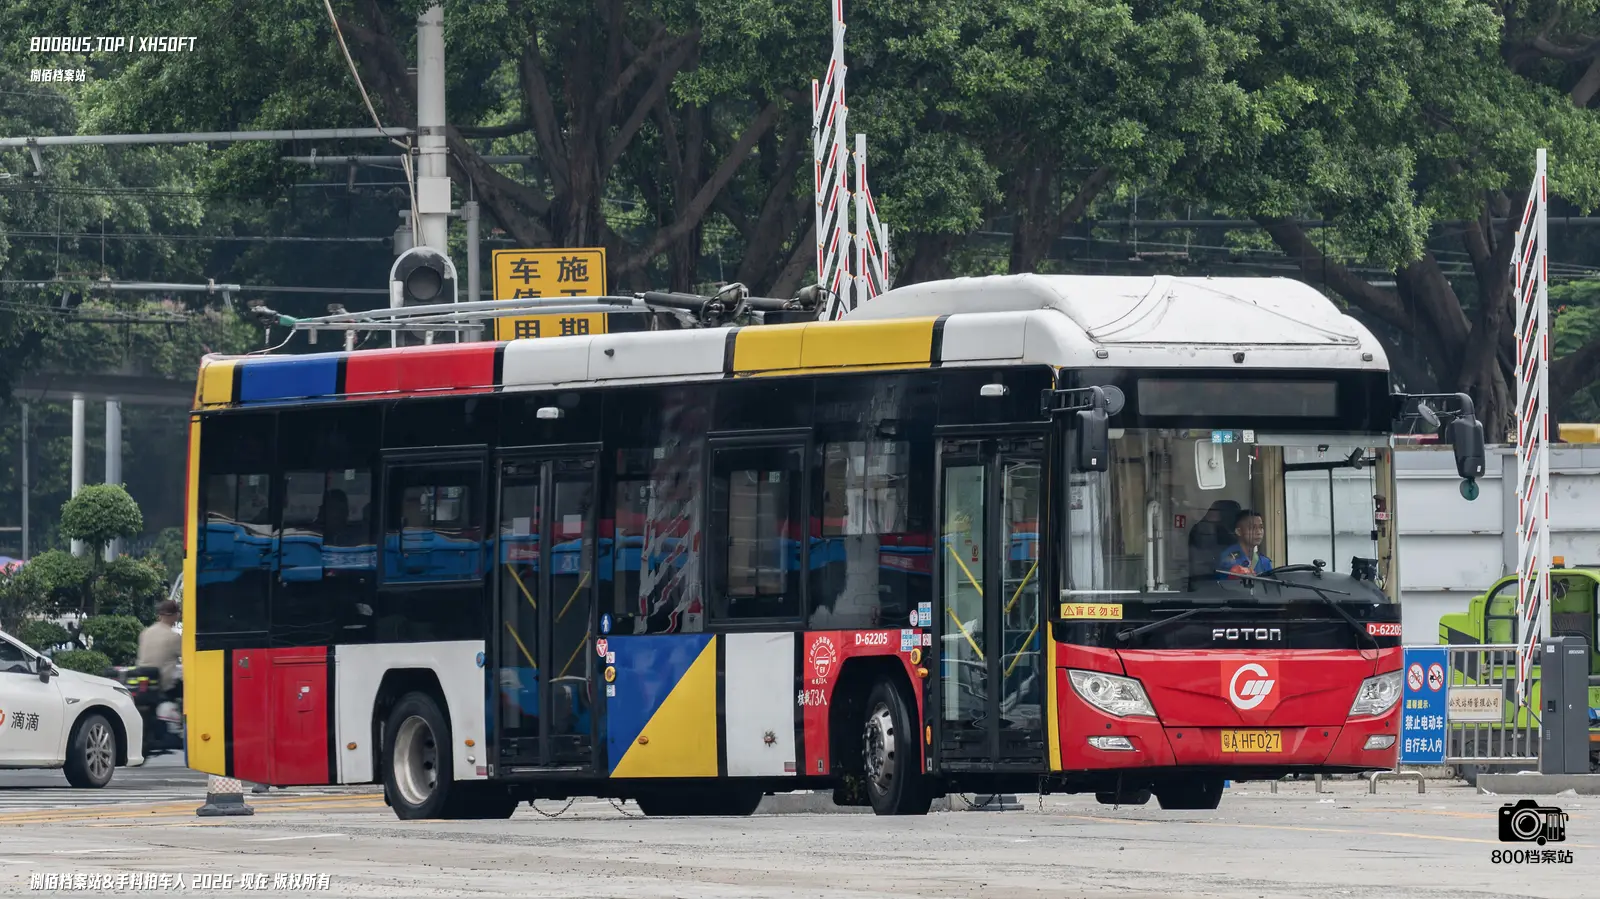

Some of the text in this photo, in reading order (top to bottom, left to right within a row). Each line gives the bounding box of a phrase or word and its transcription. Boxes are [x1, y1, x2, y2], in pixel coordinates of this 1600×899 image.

[1075, 606, 1120, 618] 盲区勿近
[855, 632, 888, 646] D-62205
[1212, 628, 1281, 641] FOTON
[11, 711, 40, 731] 滴滴
[1405, 715, 1443, 731] 禁止电动车
[1405, 738, 1442, 753] 自行车入内
